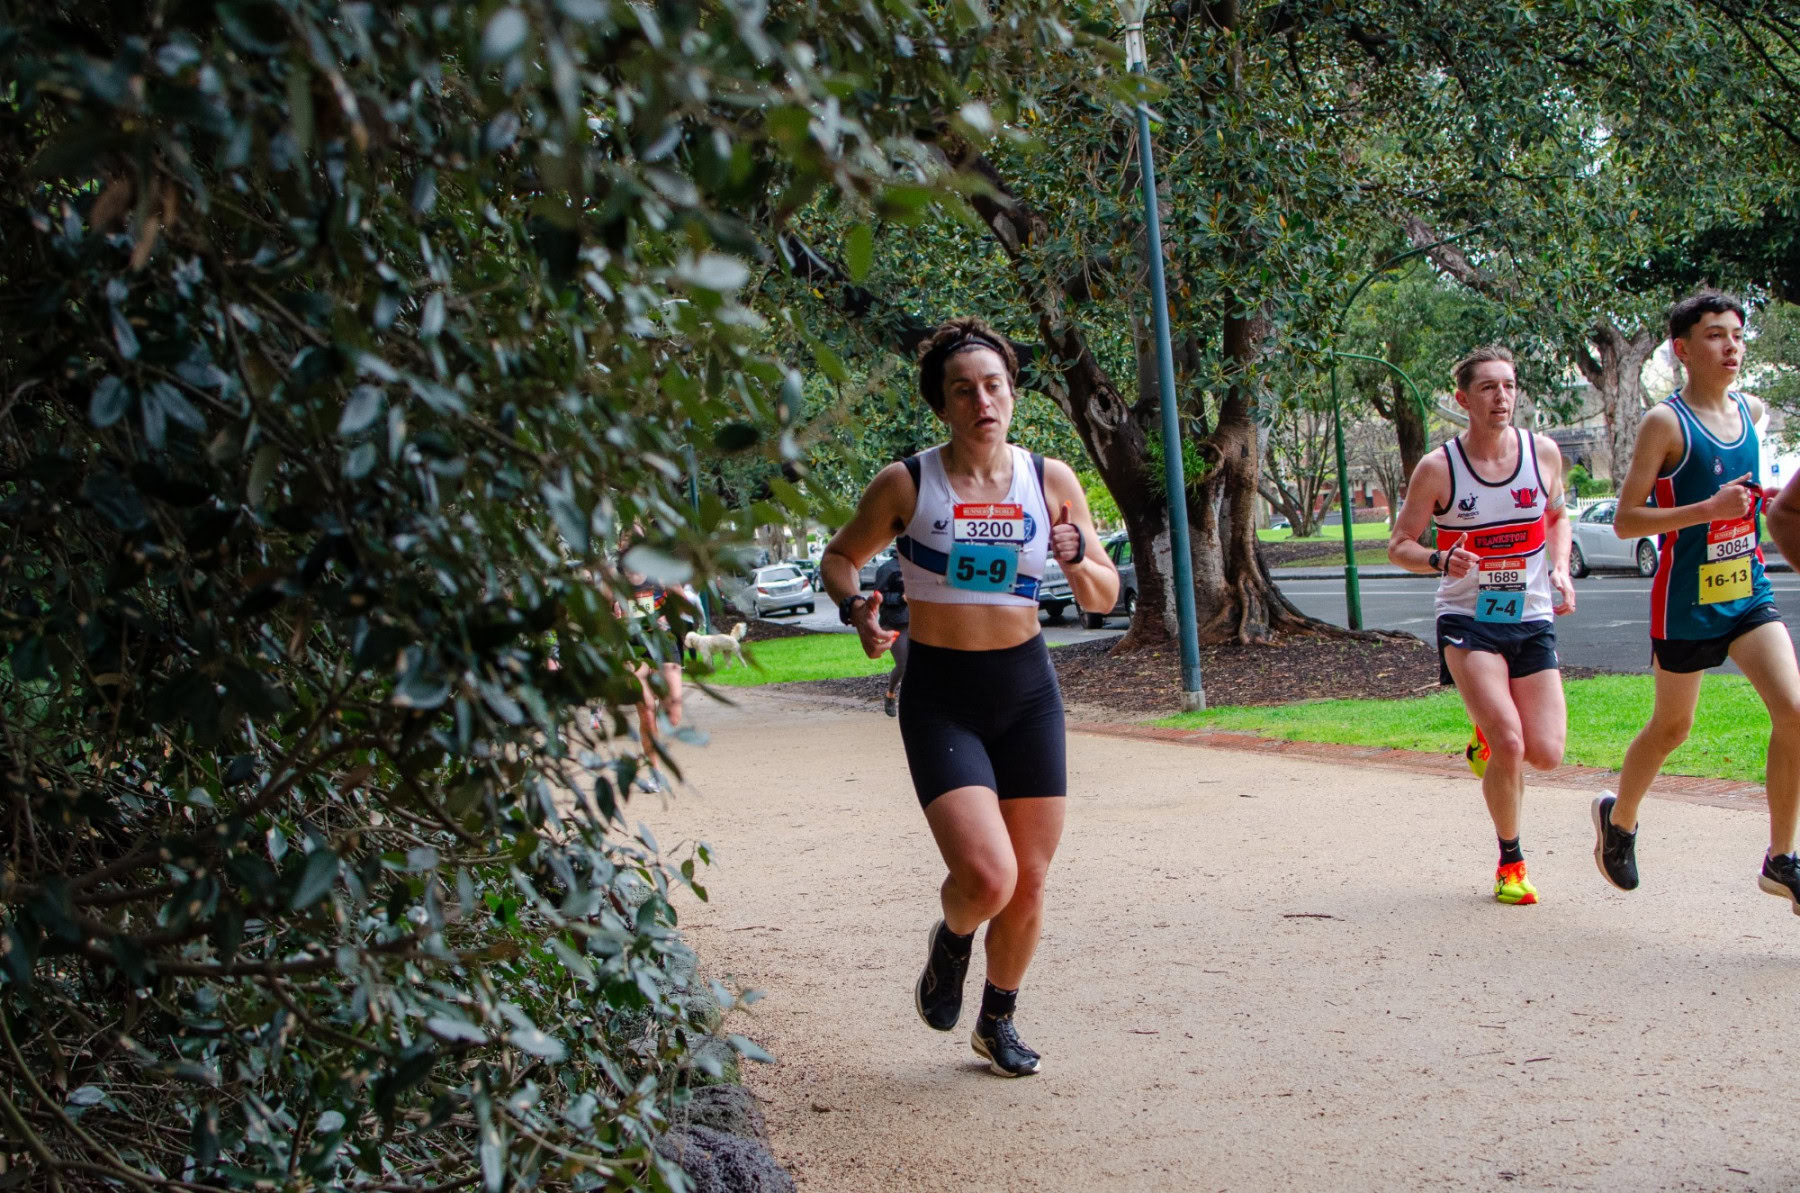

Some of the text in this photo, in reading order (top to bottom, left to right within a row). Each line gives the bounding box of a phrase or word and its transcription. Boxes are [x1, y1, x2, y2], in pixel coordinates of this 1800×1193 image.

[967, 521, 1013, 537] 3200
[1477, 531, 1526, 546] FRANKSTON
[1716, 537, 1748, 557] 3084
[956, 556, 1007, 583] 5-9
[1487, 571, 1518, 583] 1689
[1705, 569, 1747, 588] 16-13
[1485, 598, 1516, 616] 7-4
